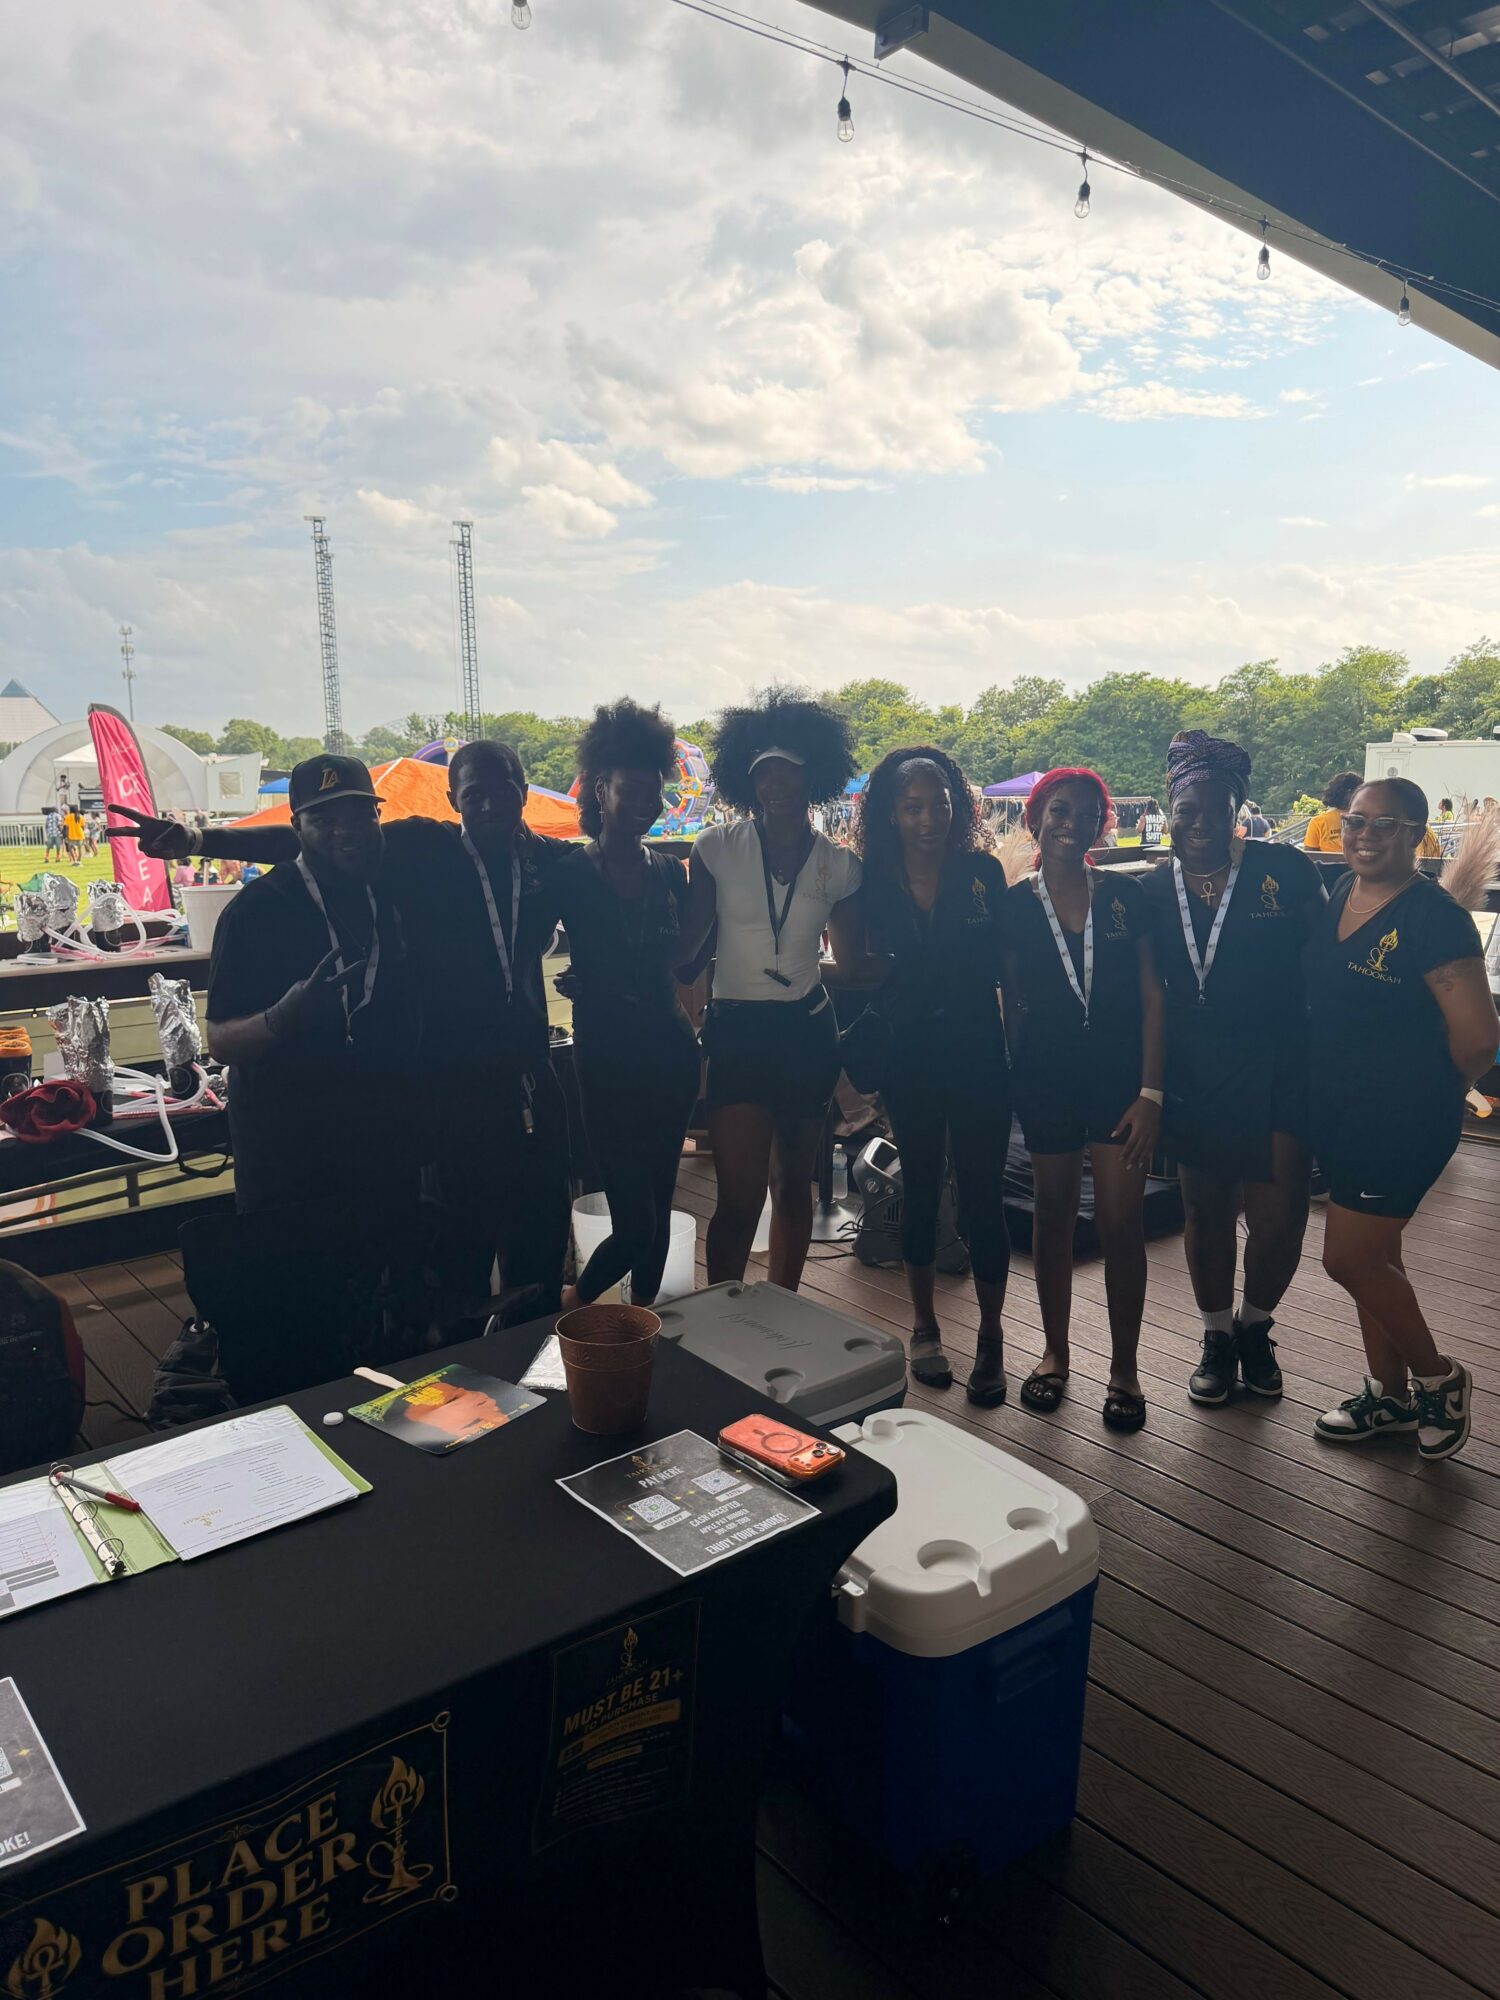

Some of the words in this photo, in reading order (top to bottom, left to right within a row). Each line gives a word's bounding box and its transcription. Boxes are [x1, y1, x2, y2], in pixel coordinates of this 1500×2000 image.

[319, 768, 340, 791] LA
[1347, 961, 1402, 984] TAHOOKAH
[637, 1475, 661, 1489] PAY
[657, 1466, 685, 1481] HERE
[689, 1514, 709, 1528] CASH
[705, 1538, 735, 1555] ENJOY
[730, 1527, 759, 1542] YOUR
[753, 1512, 789, 1532] SMOKE!
[563, 1693, 617, 1737] MUST
[620, 1677, 644, 1701] BE
[648, 1665, 685, 1692] 21+
[583, 1719, 599, 1734] TO
[601, 1693, 660, 1727] PURCHASE
[124, 1791, 339, 1924] PLACE
[102, 1832, 364, 1977] ORDER
[147, 1893, 331, 2000] HERE
